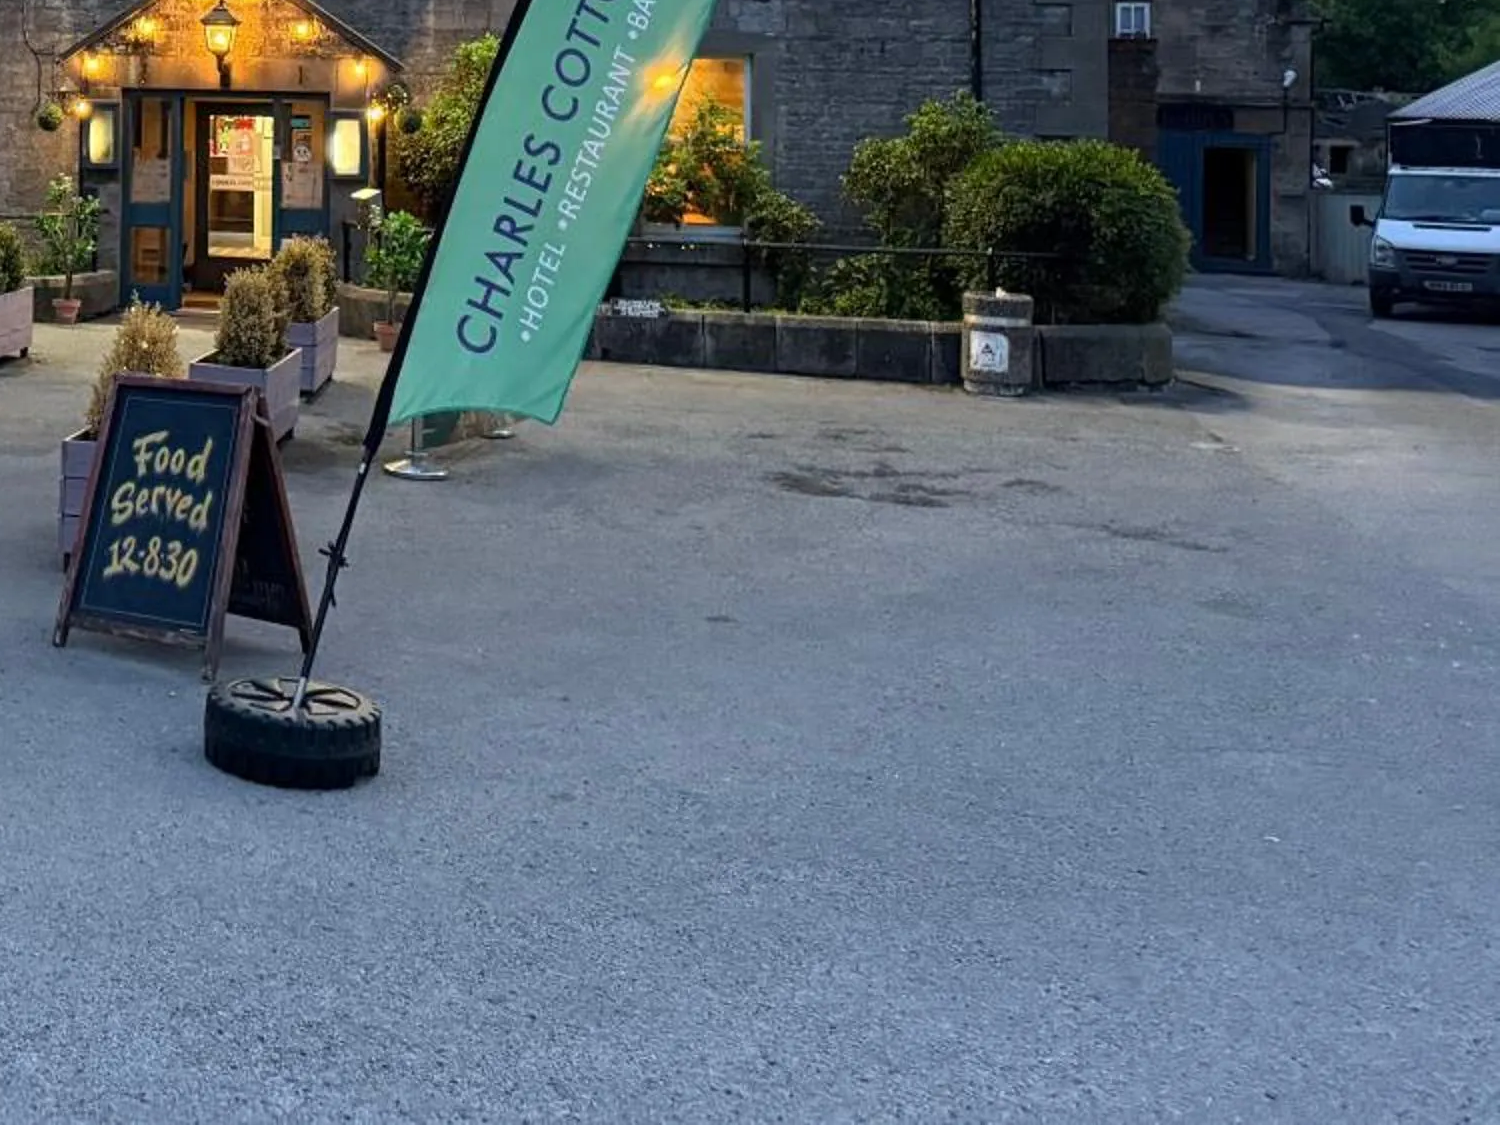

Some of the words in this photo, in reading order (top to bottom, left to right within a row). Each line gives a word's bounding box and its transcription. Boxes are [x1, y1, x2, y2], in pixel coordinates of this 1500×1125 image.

[457, 133, 561, 354] CHARLES
[132, 429, 213, 485] Food
[111, 481, 213, 533] Served
